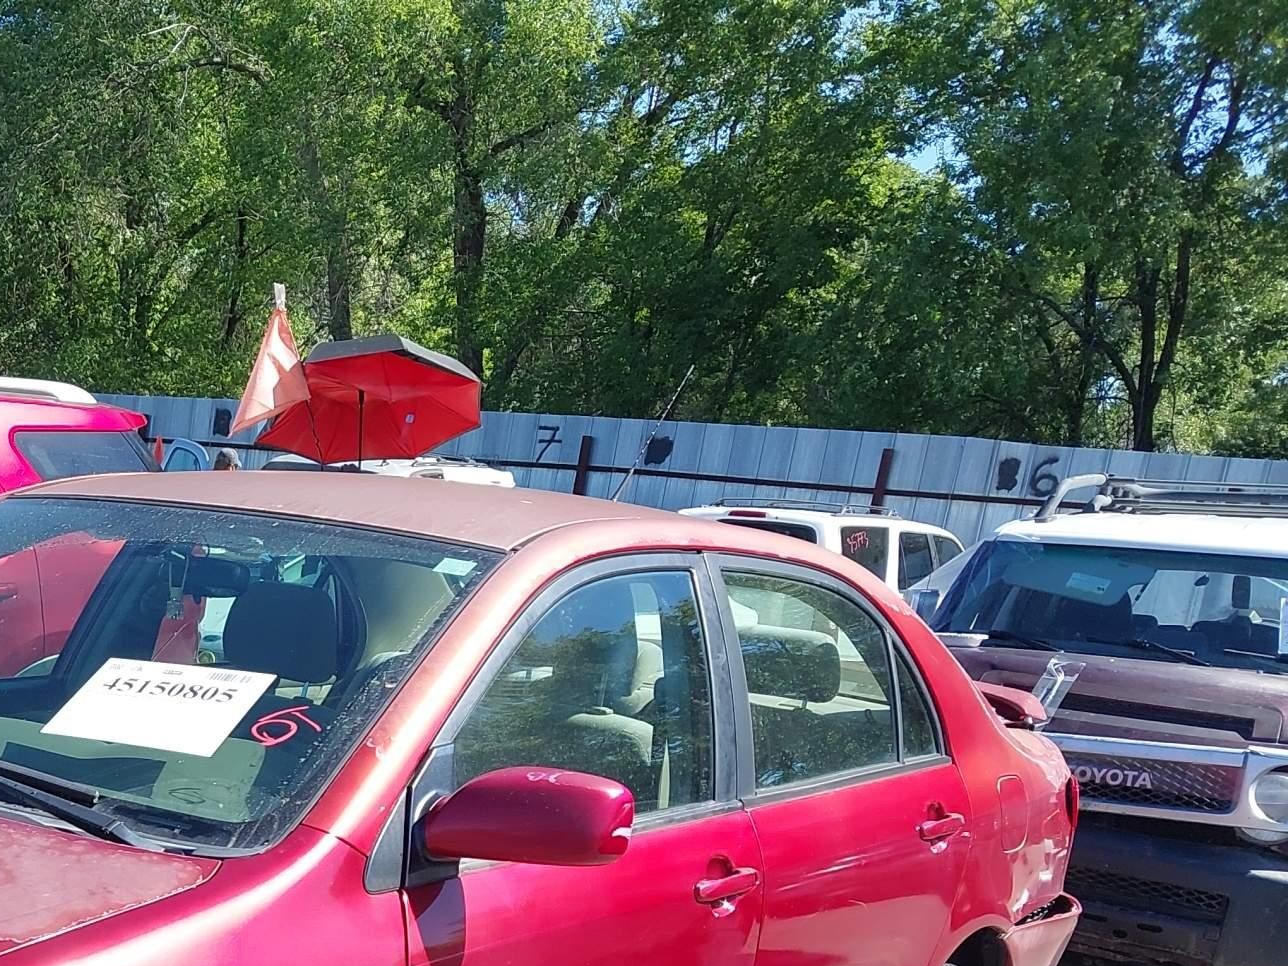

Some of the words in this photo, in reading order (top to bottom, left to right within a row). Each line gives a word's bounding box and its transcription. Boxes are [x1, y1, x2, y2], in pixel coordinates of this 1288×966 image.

[535, 425, 563, 463] 7
[1030, 456, 1060, 497] 6
[103, 676, 238, 703] 45150805
[1072, 765, 1153, 789] OYOTA
